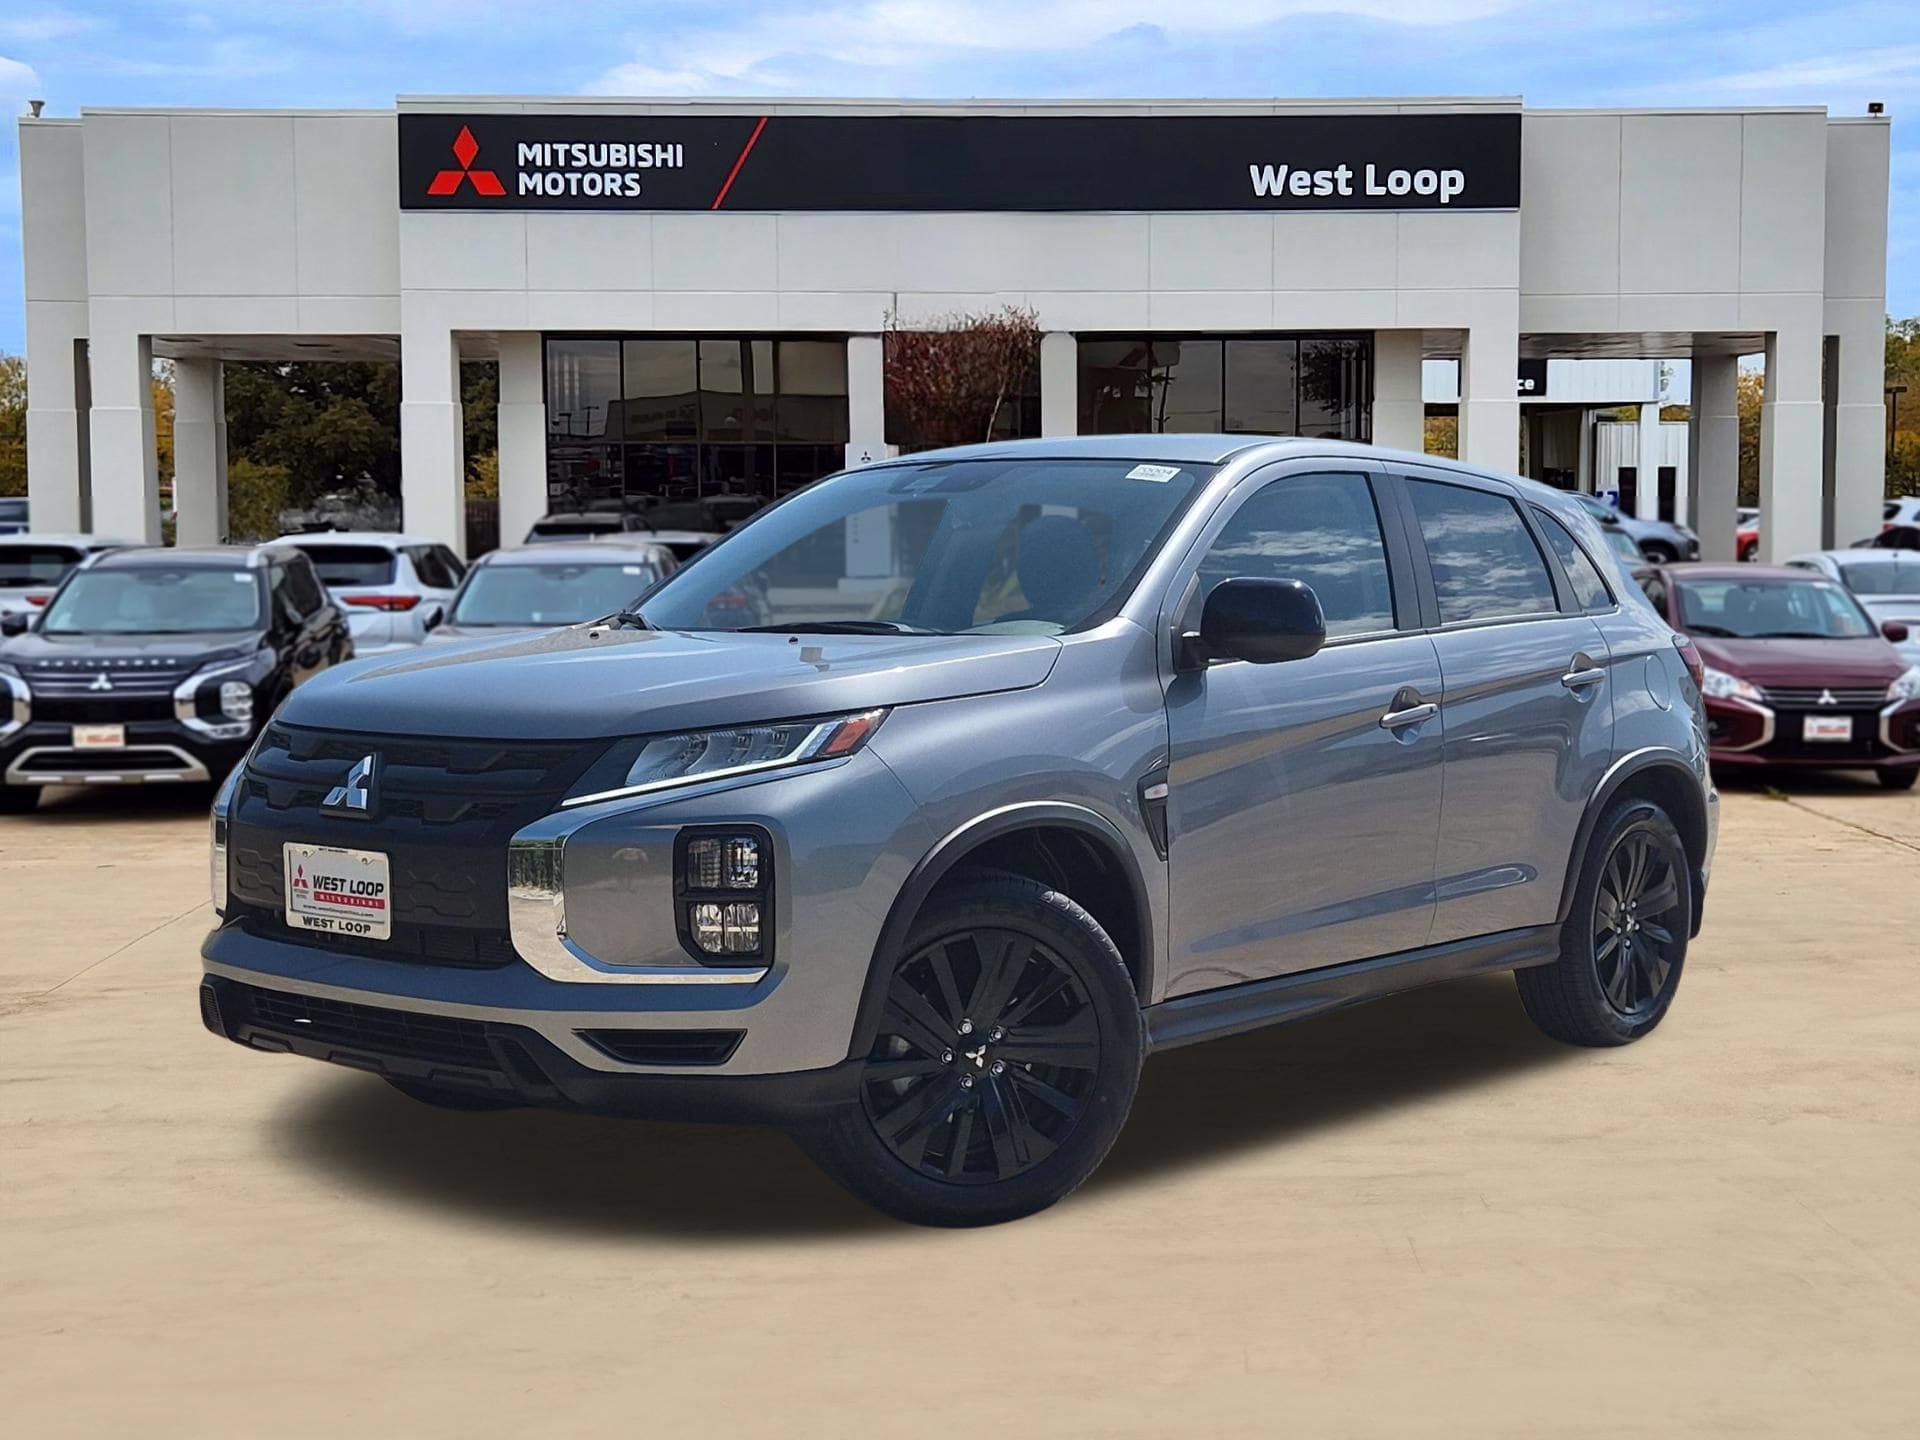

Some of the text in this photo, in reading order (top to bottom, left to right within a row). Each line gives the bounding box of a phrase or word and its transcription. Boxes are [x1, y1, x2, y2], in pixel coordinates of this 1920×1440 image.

[518, 143, 683, 168] MITSUBISHI
[518, 172, 641, 196] MOTORS
[1250, 164, 1465, 203] West Loop
[312, 875, 385, 897] WEST LOOP
[302, 916, 371, 934] WEST LOOP
